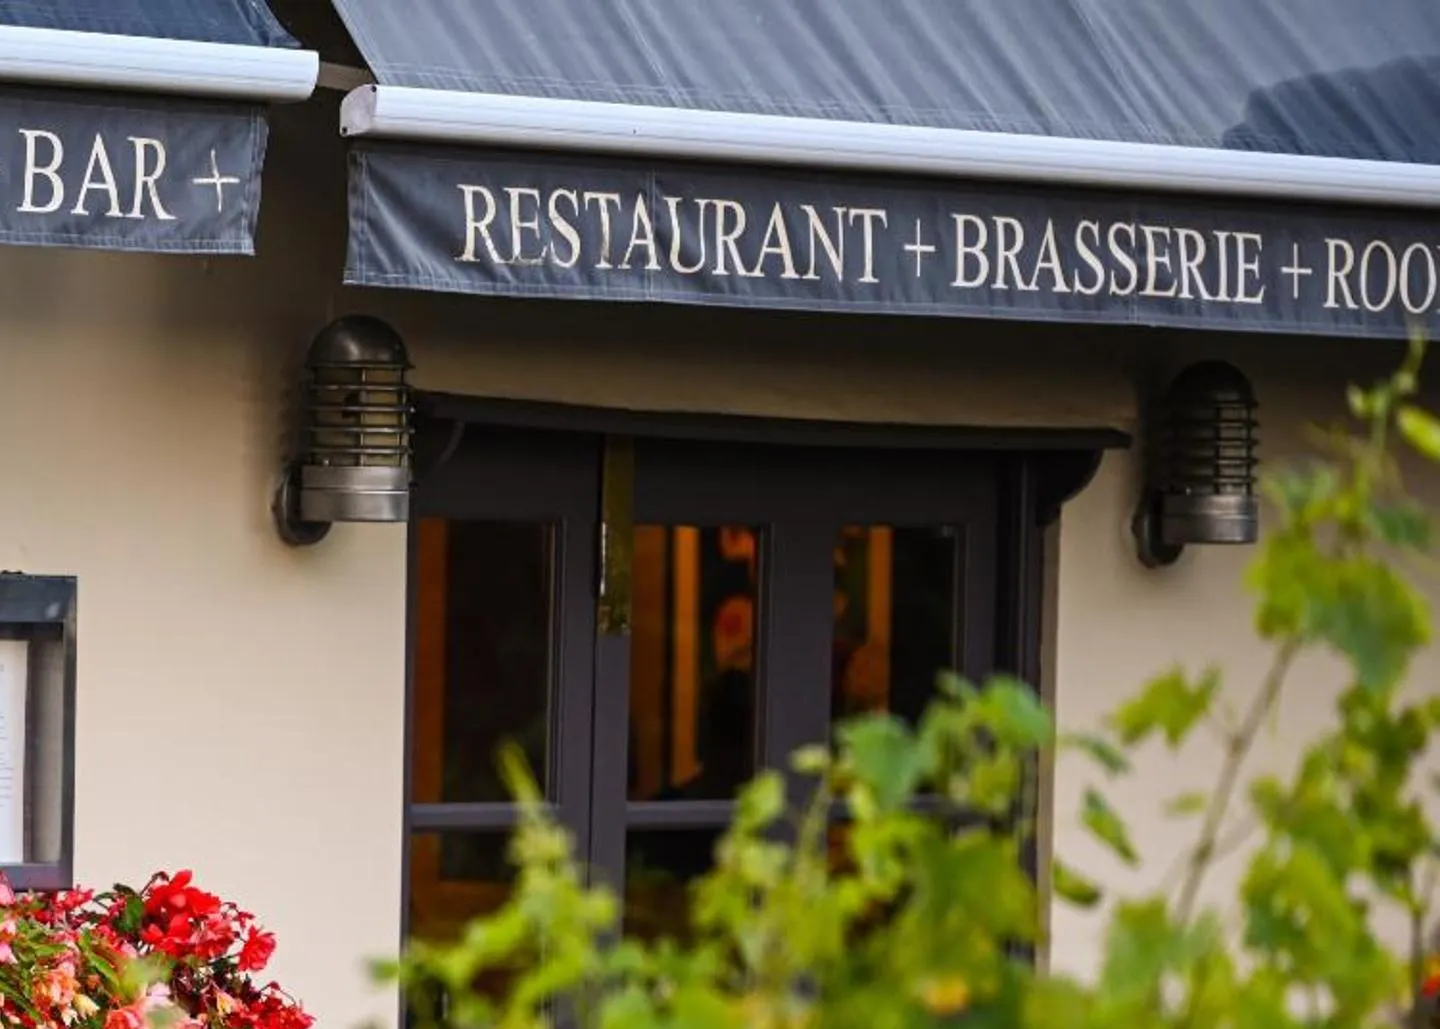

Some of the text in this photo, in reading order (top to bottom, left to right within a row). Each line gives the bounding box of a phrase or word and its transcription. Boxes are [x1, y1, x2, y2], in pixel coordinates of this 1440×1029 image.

[15, 128, 177, 221] BAR
[456, 183, 888, 284] RESTAURANT
[950, 213, 1265, 304] BRASSERIE
[1322, 237, 1440, 314] ROO
